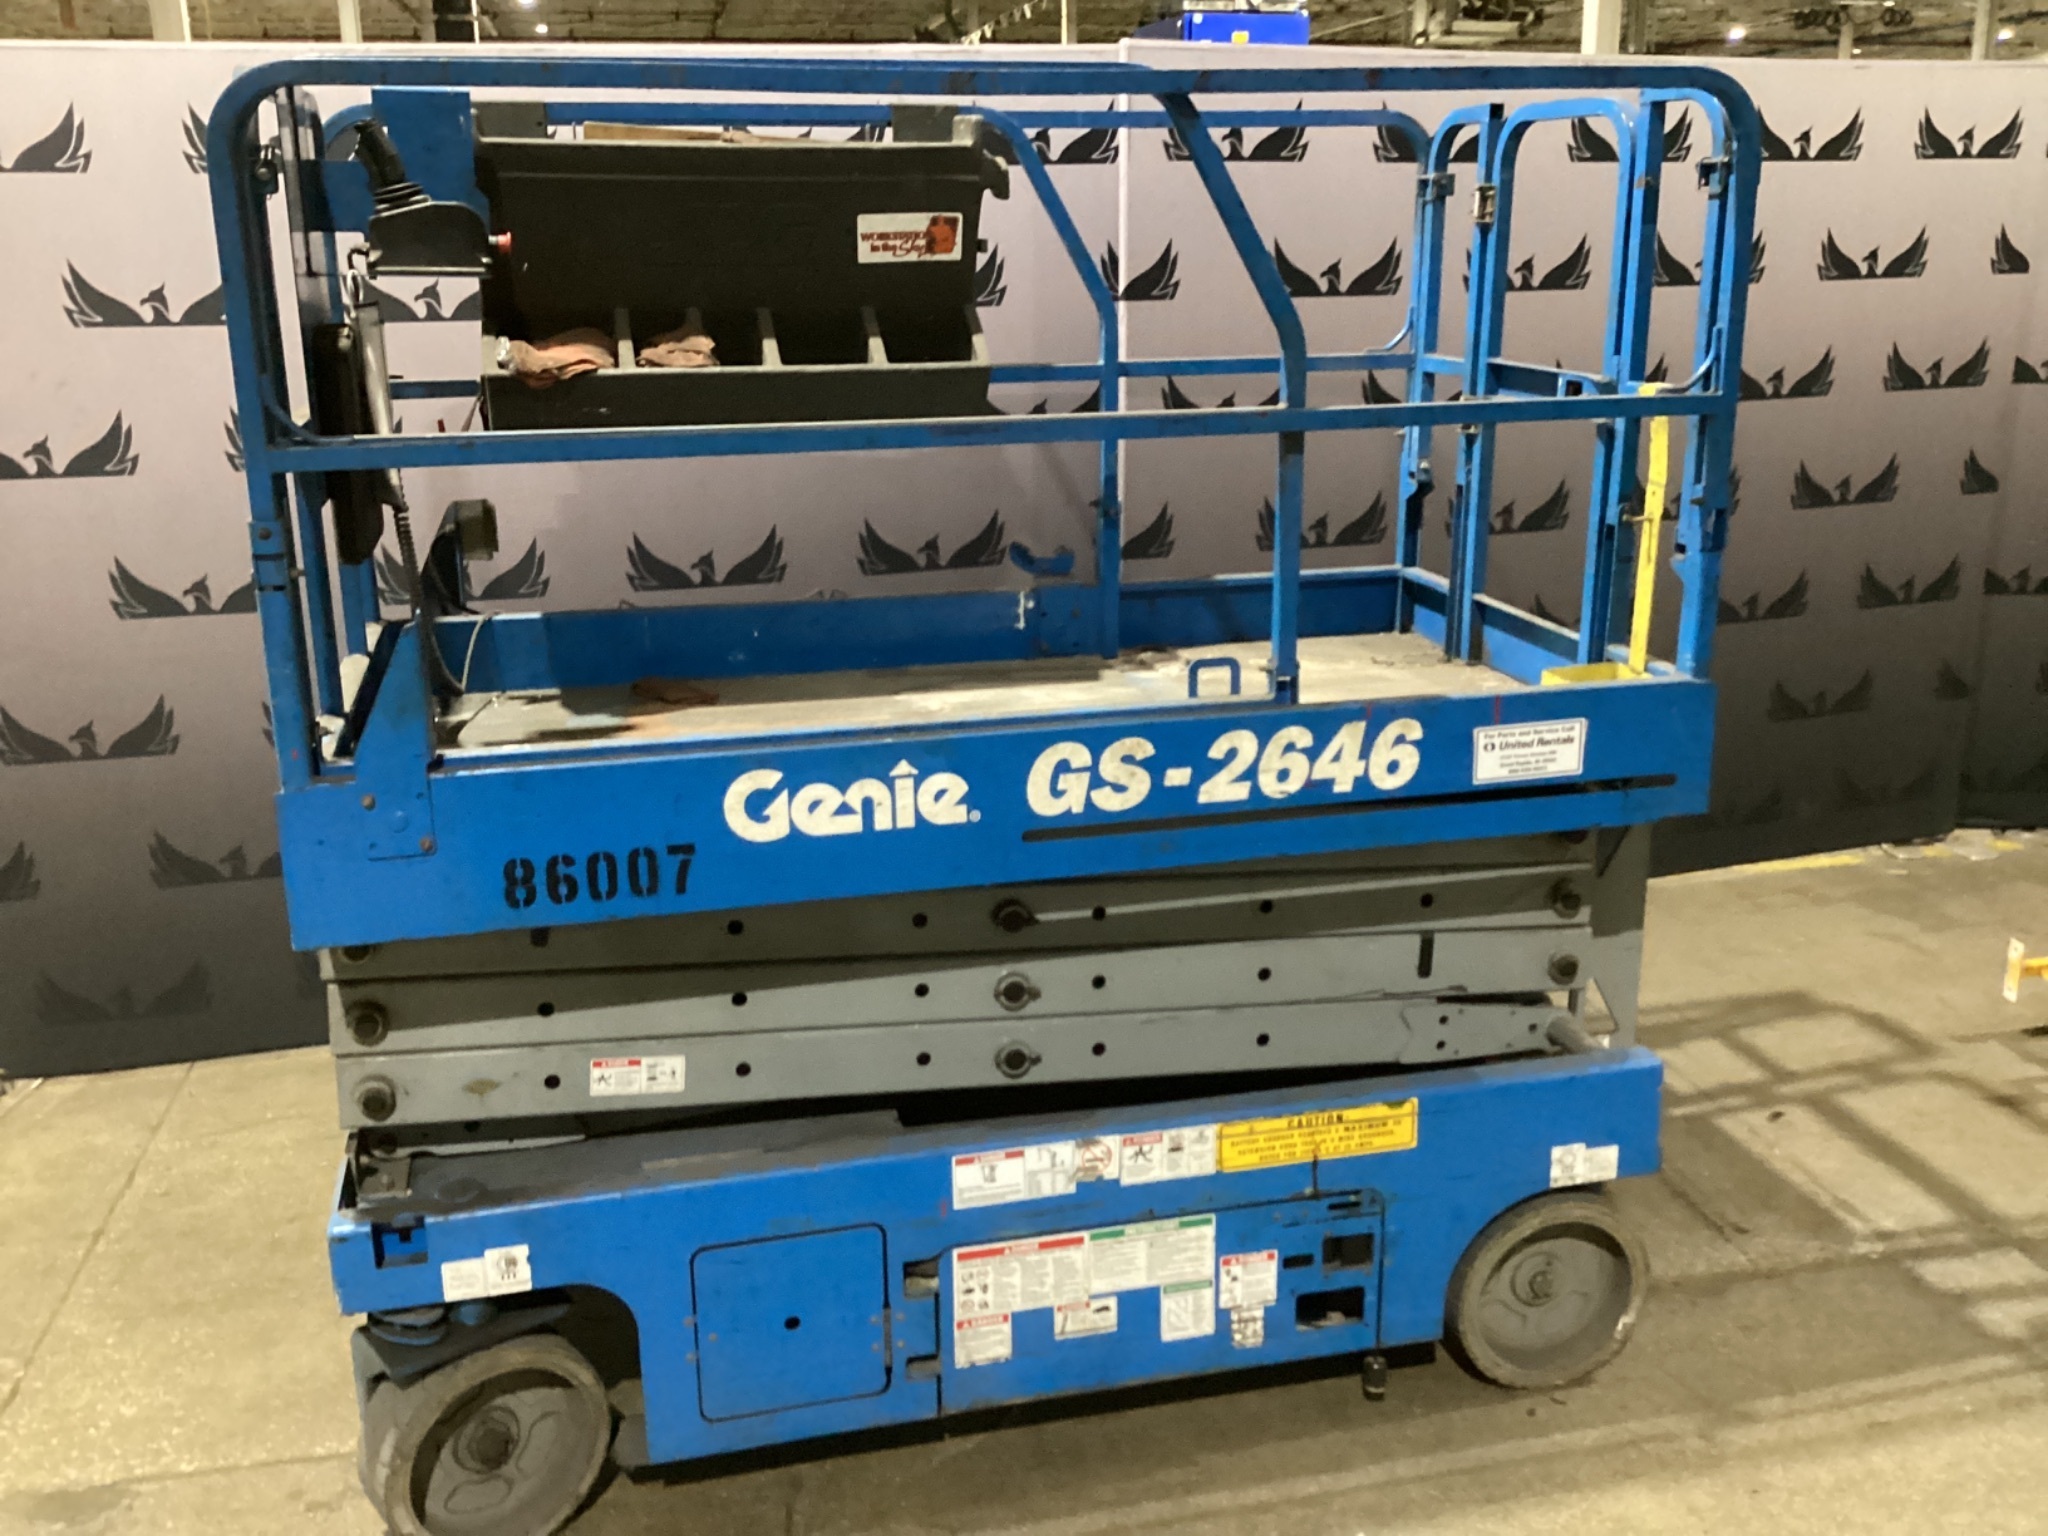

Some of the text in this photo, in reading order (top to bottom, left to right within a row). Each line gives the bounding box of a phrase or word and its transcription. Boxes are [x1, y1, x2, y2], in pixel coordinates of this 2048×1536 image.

[1027, 719, 1423, 816] GS-2646
[1499, 734, 1575, 750] United Rentals
[724, 760, 969, 842] Genie
[503, 843, 697, 909] 86007
[1287, 1113, 1344, 1129] CAUTION
